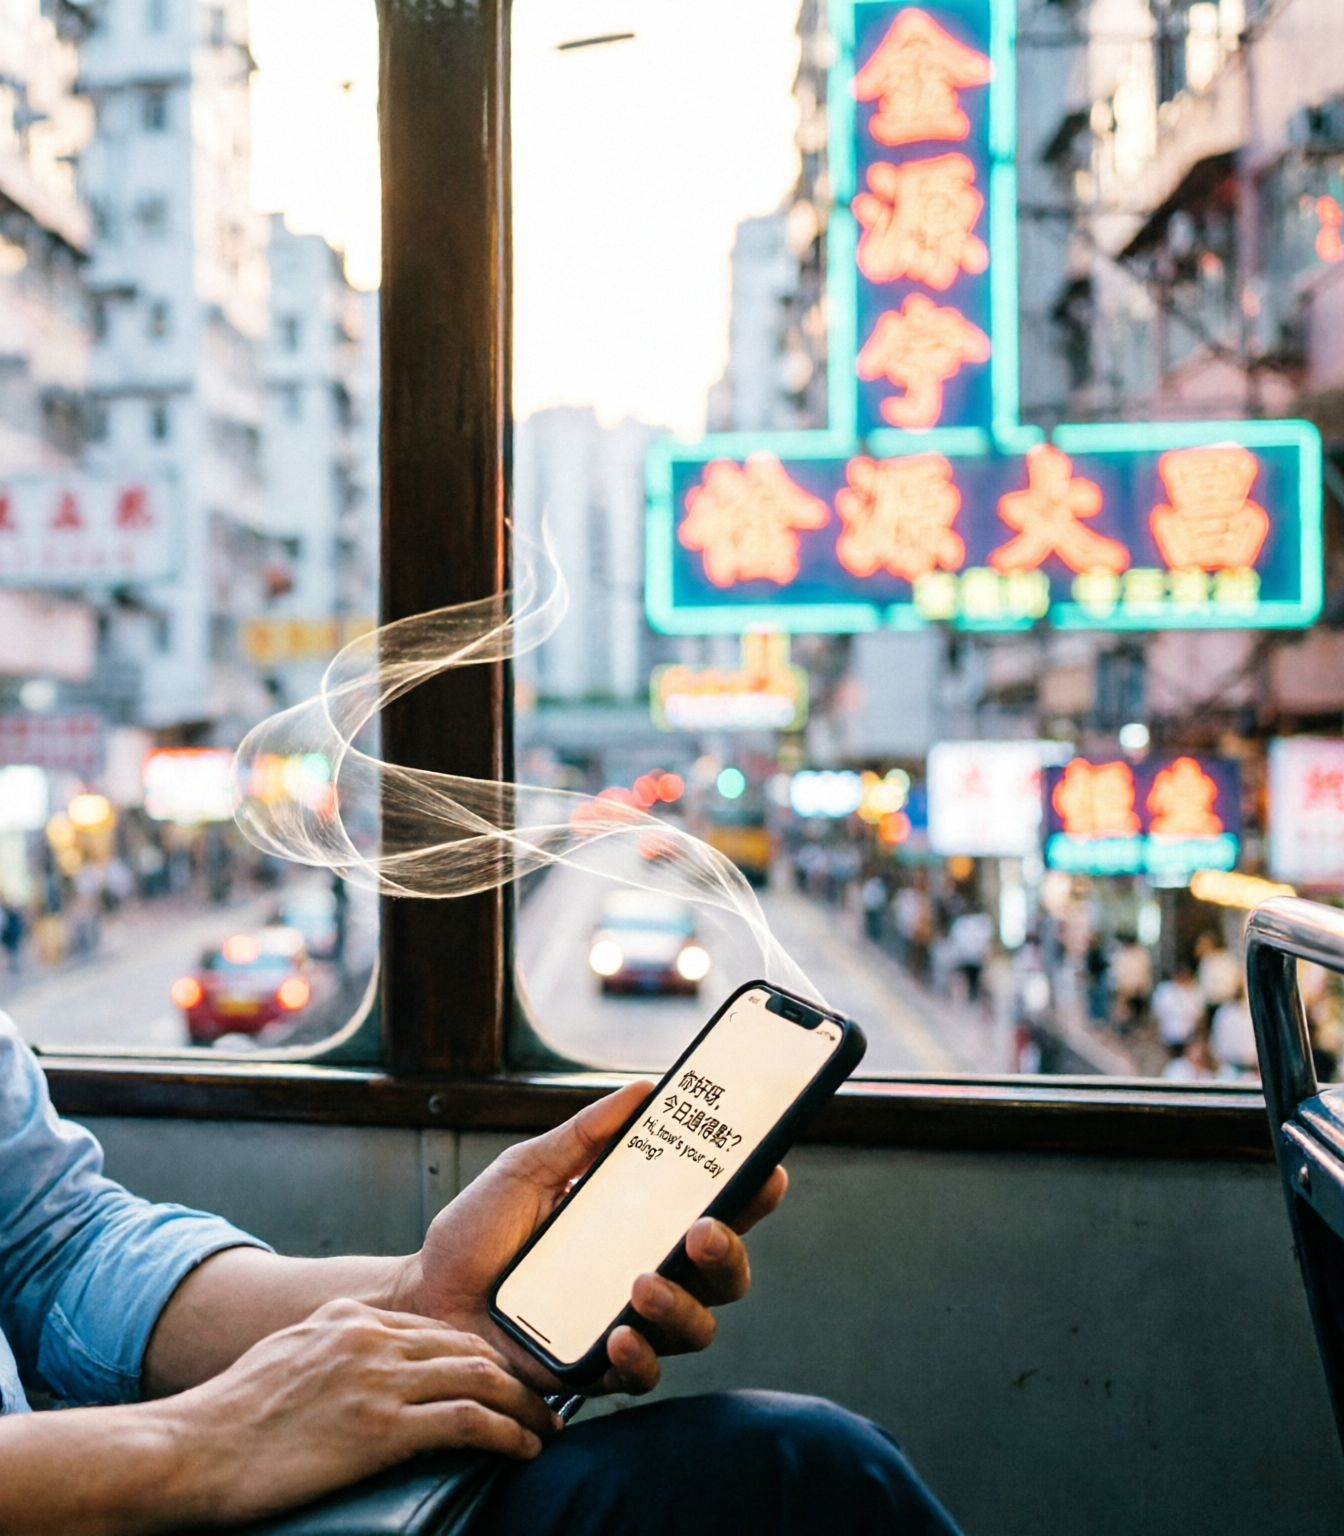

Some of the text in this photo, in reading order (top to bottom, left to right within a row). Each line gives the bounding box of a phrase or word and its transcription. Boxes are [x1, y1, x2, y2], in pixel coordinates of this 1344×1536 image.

[627, 1135, 664, 1160] going?
[642, 1116, 725, 1179] Hi, how's your day
